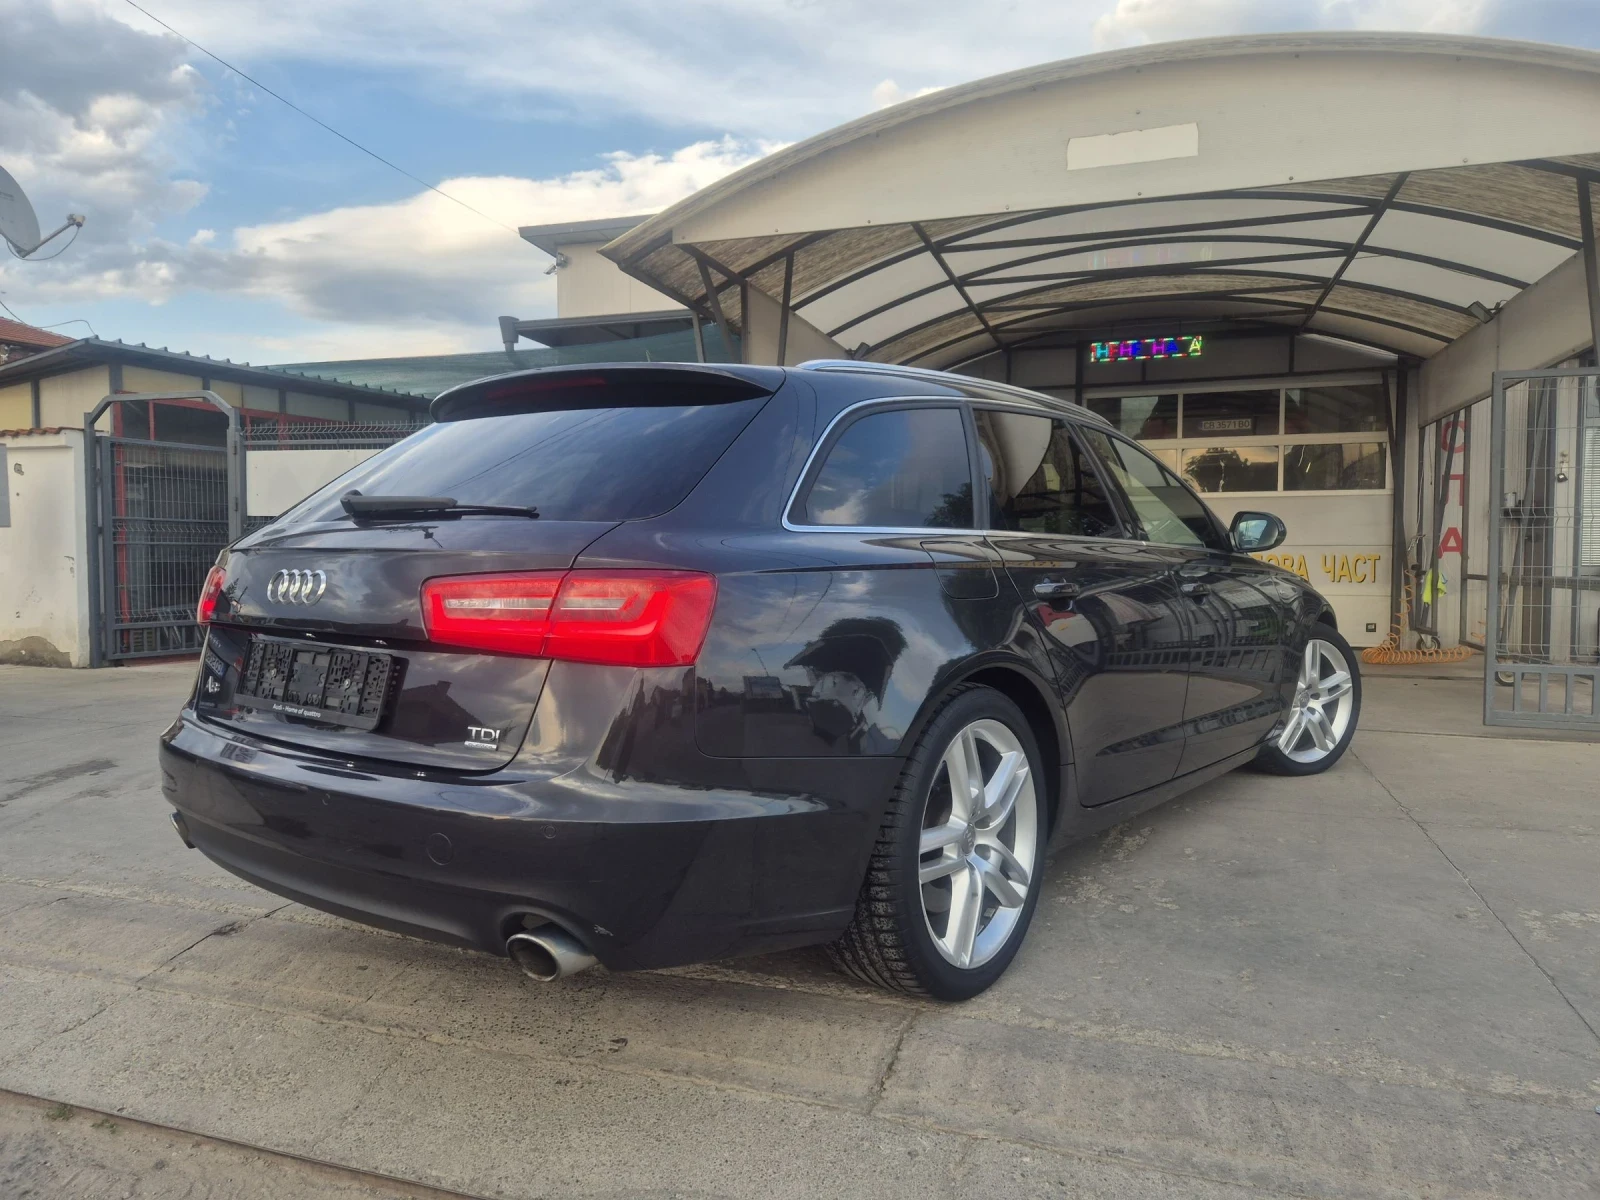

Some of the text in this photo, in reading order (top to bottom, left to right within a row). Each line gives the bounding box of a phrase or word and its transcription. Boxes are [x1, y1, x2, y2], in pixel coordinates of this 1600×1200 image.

[1216, 420, 1237, 429] 3571
[1321, 553, 1381, 583] ЧАСТ
[272, 703, 283, 711] Audi
[284, 705, 297, 714] Home
[303, 710, 321, 718] quattro
[467, 726, 500, 740] TDI
